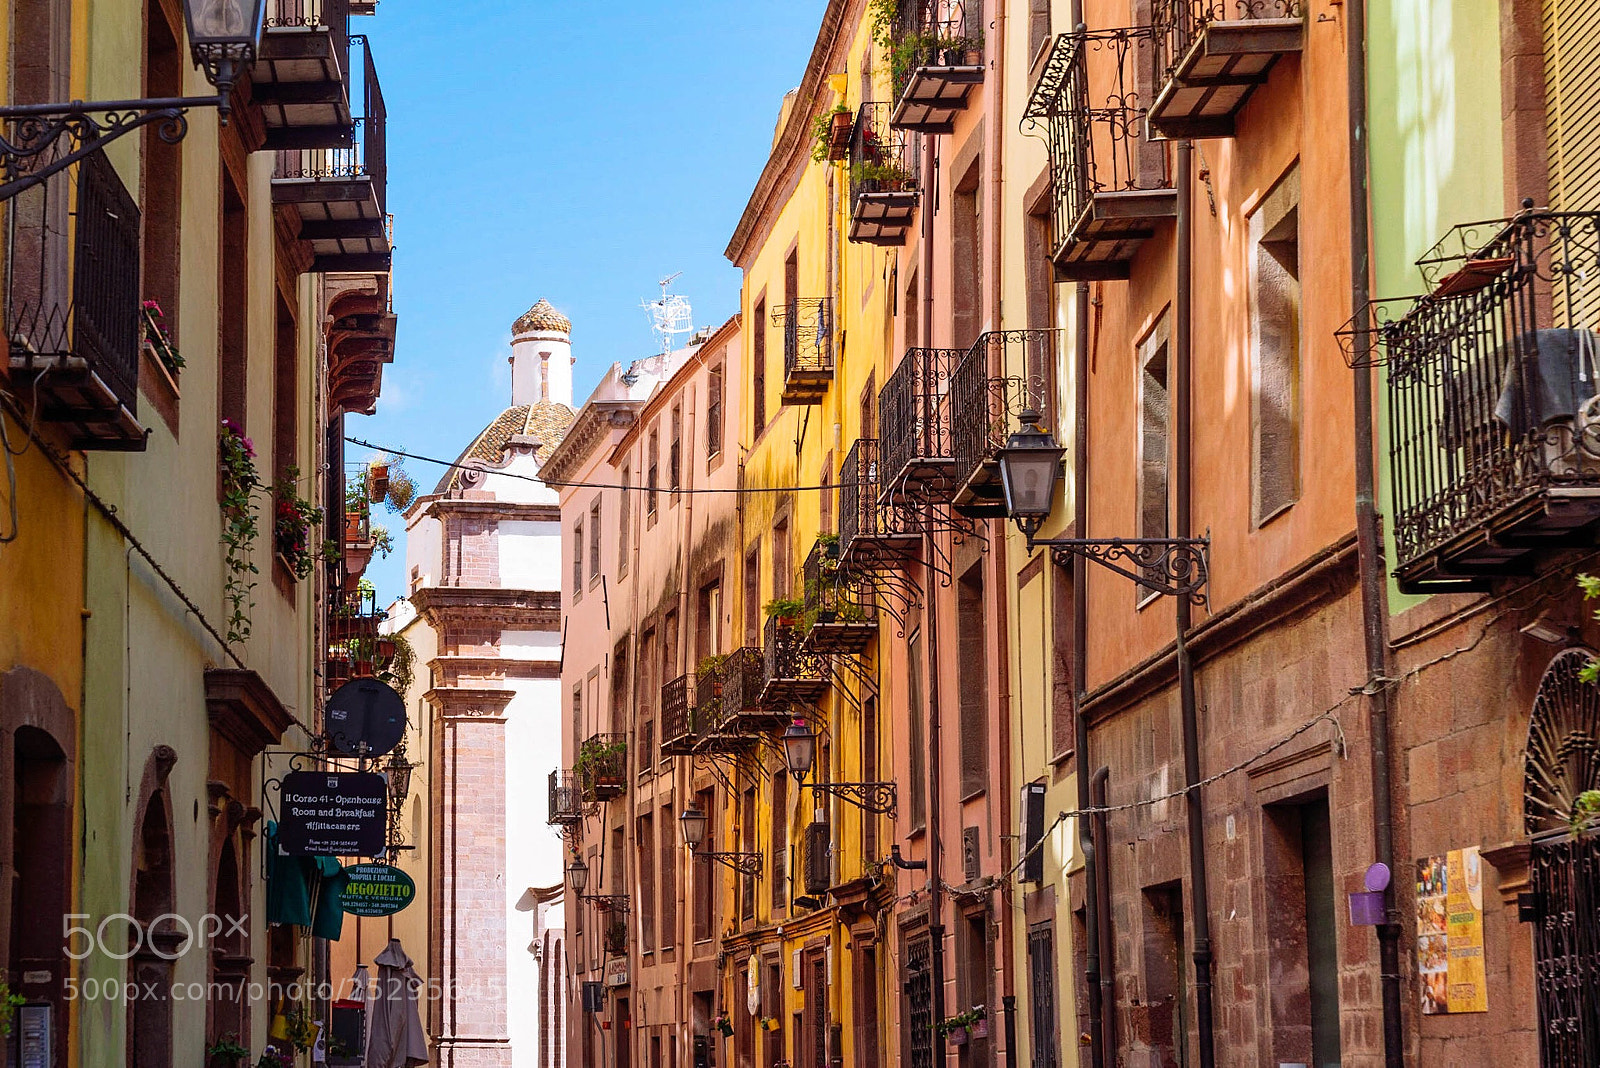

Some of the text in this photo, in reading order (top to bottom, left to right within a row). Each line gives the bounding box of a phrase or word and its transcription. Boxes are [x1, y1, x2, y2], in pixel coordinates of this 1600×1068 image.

[292, 793, 318, 803] Corso
[319, 795, 328, 803] 41
[335, 794, 382, 806] Openhouse
[291, 807, 375, 818] Room and Breakfast
[305, 821, 361, 831] Affittacamere
[346, 882, 410, 897] NEGOZIETTO
